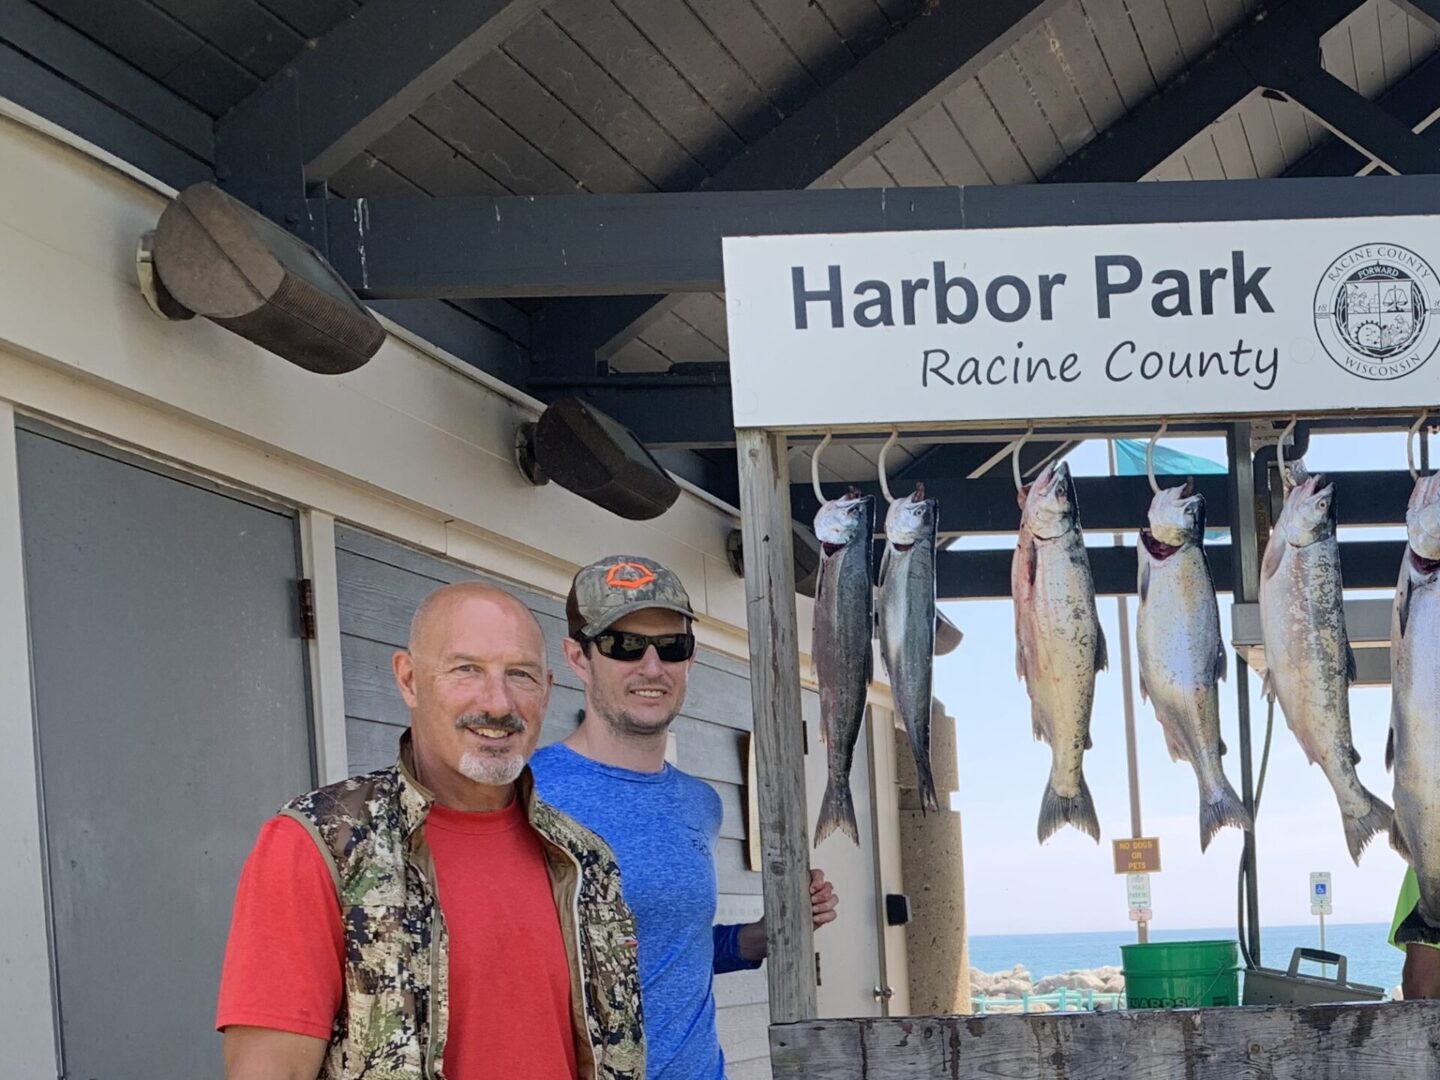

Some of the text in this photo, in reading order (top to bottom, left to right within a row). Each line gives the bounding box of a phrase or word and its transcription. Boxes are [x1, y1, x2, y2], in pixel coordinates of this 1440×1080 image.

[1327, 247, 1431, 282] RACINE COUNTY
[1358, 266, 1400, 279] FORWARD
[790, 250, 1276, 330] Harbor Park
[921, 338, 1279, 391] Racine County
[1345, 353, 1421, 377] WISCONSIN
[1119, 840, 1153, 850] NO DOGS
[1131, 851, 1142, 860] OR
[1128, 861, 1147, 871] PETS
